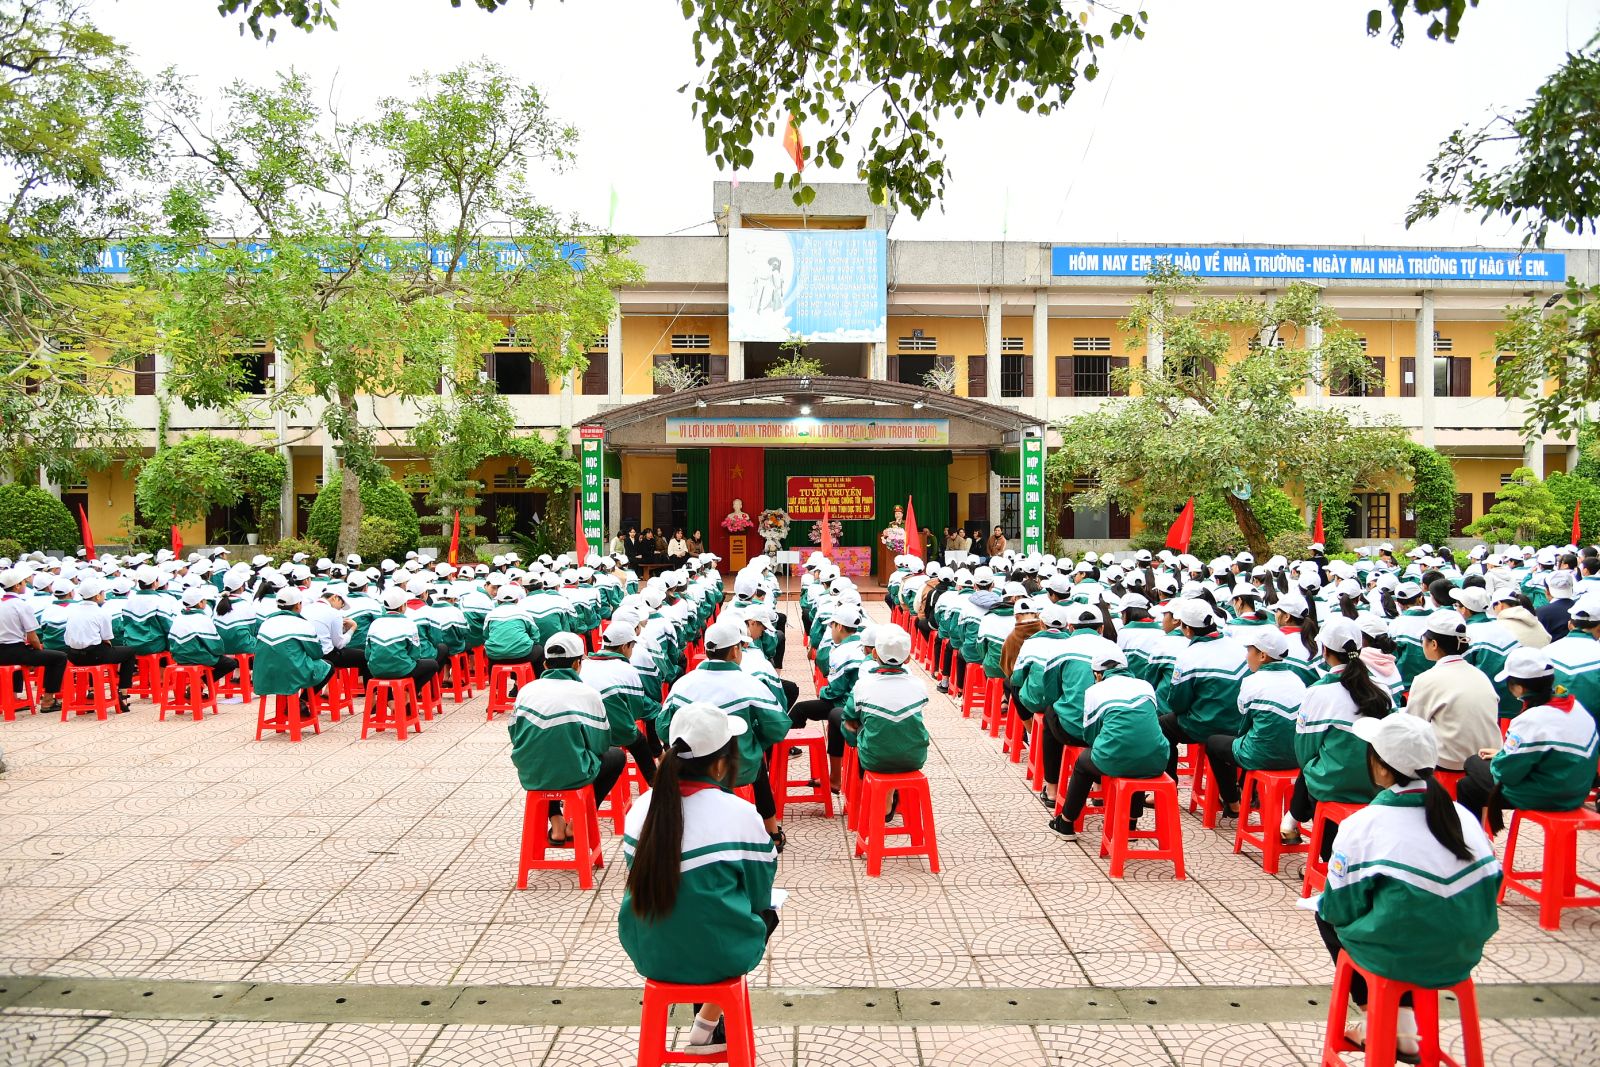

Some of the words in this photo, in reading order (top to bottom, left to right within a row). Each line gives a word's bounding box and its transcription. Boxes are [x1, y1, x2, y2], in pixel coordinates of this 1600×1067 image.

[1069, 251, 1098, 271] HÔM
[1103, 255, 1127, 271] NAY
[1132, 255, 1152, 271] EM
[1175, 252, 1201, 271] HÀO
[1204, 250, 1220, 272] VỀ
[1224, 253, 1250, 272] NHÀ
[1350, 257, 1374, 274] MAI
[1379, 255, 1404, 274] NHÀ
[1408, 255, 1457, 275] TRƯỜNG
[1460, 257, 1477, 278] TỰ
[1479, 256, 1504, 275] HÀO
[1507, 255, 1522, 276] VỀ
[1526, 259, 1548, 276] EM.
[680, 423, 686, 438] VÌ
[689, 424, 699, 440] LỢI
[703, 422, 715, 438] ÍCH
[718, 423, 737, 438] MƯỜI
[739, 422, 755, 438] NĂM
[758, 422, 782, 438] TRỒNG
[818, 424, 829, 440] LỢI
[832, 422, 845, 438] ÍCH
[847, 424, 866, 438] TRĂM
[888, 421, 913, 439] TRỒNG
[915, 423, 938, 439] NGƯỜI
[586, 457, 598, 470] HỌC
[1026, 456, 1039, 470] HỢP
[586, 472, 598, 488] TẬP,
[1026, 472, 1039, 487] TÁC,
[587, 492, 598, 503] LAO
[799, 487, 828, 497] TUYÊN
[829, 487, 862, 497] TRUYỀN
[1026, 492, 1040, 503] CHIA
[584, 508, 601, 523] ĐỘNG
[585, 525, 601, 538] SÁNG
[1026, 525, 1040, 539] HIỆU
